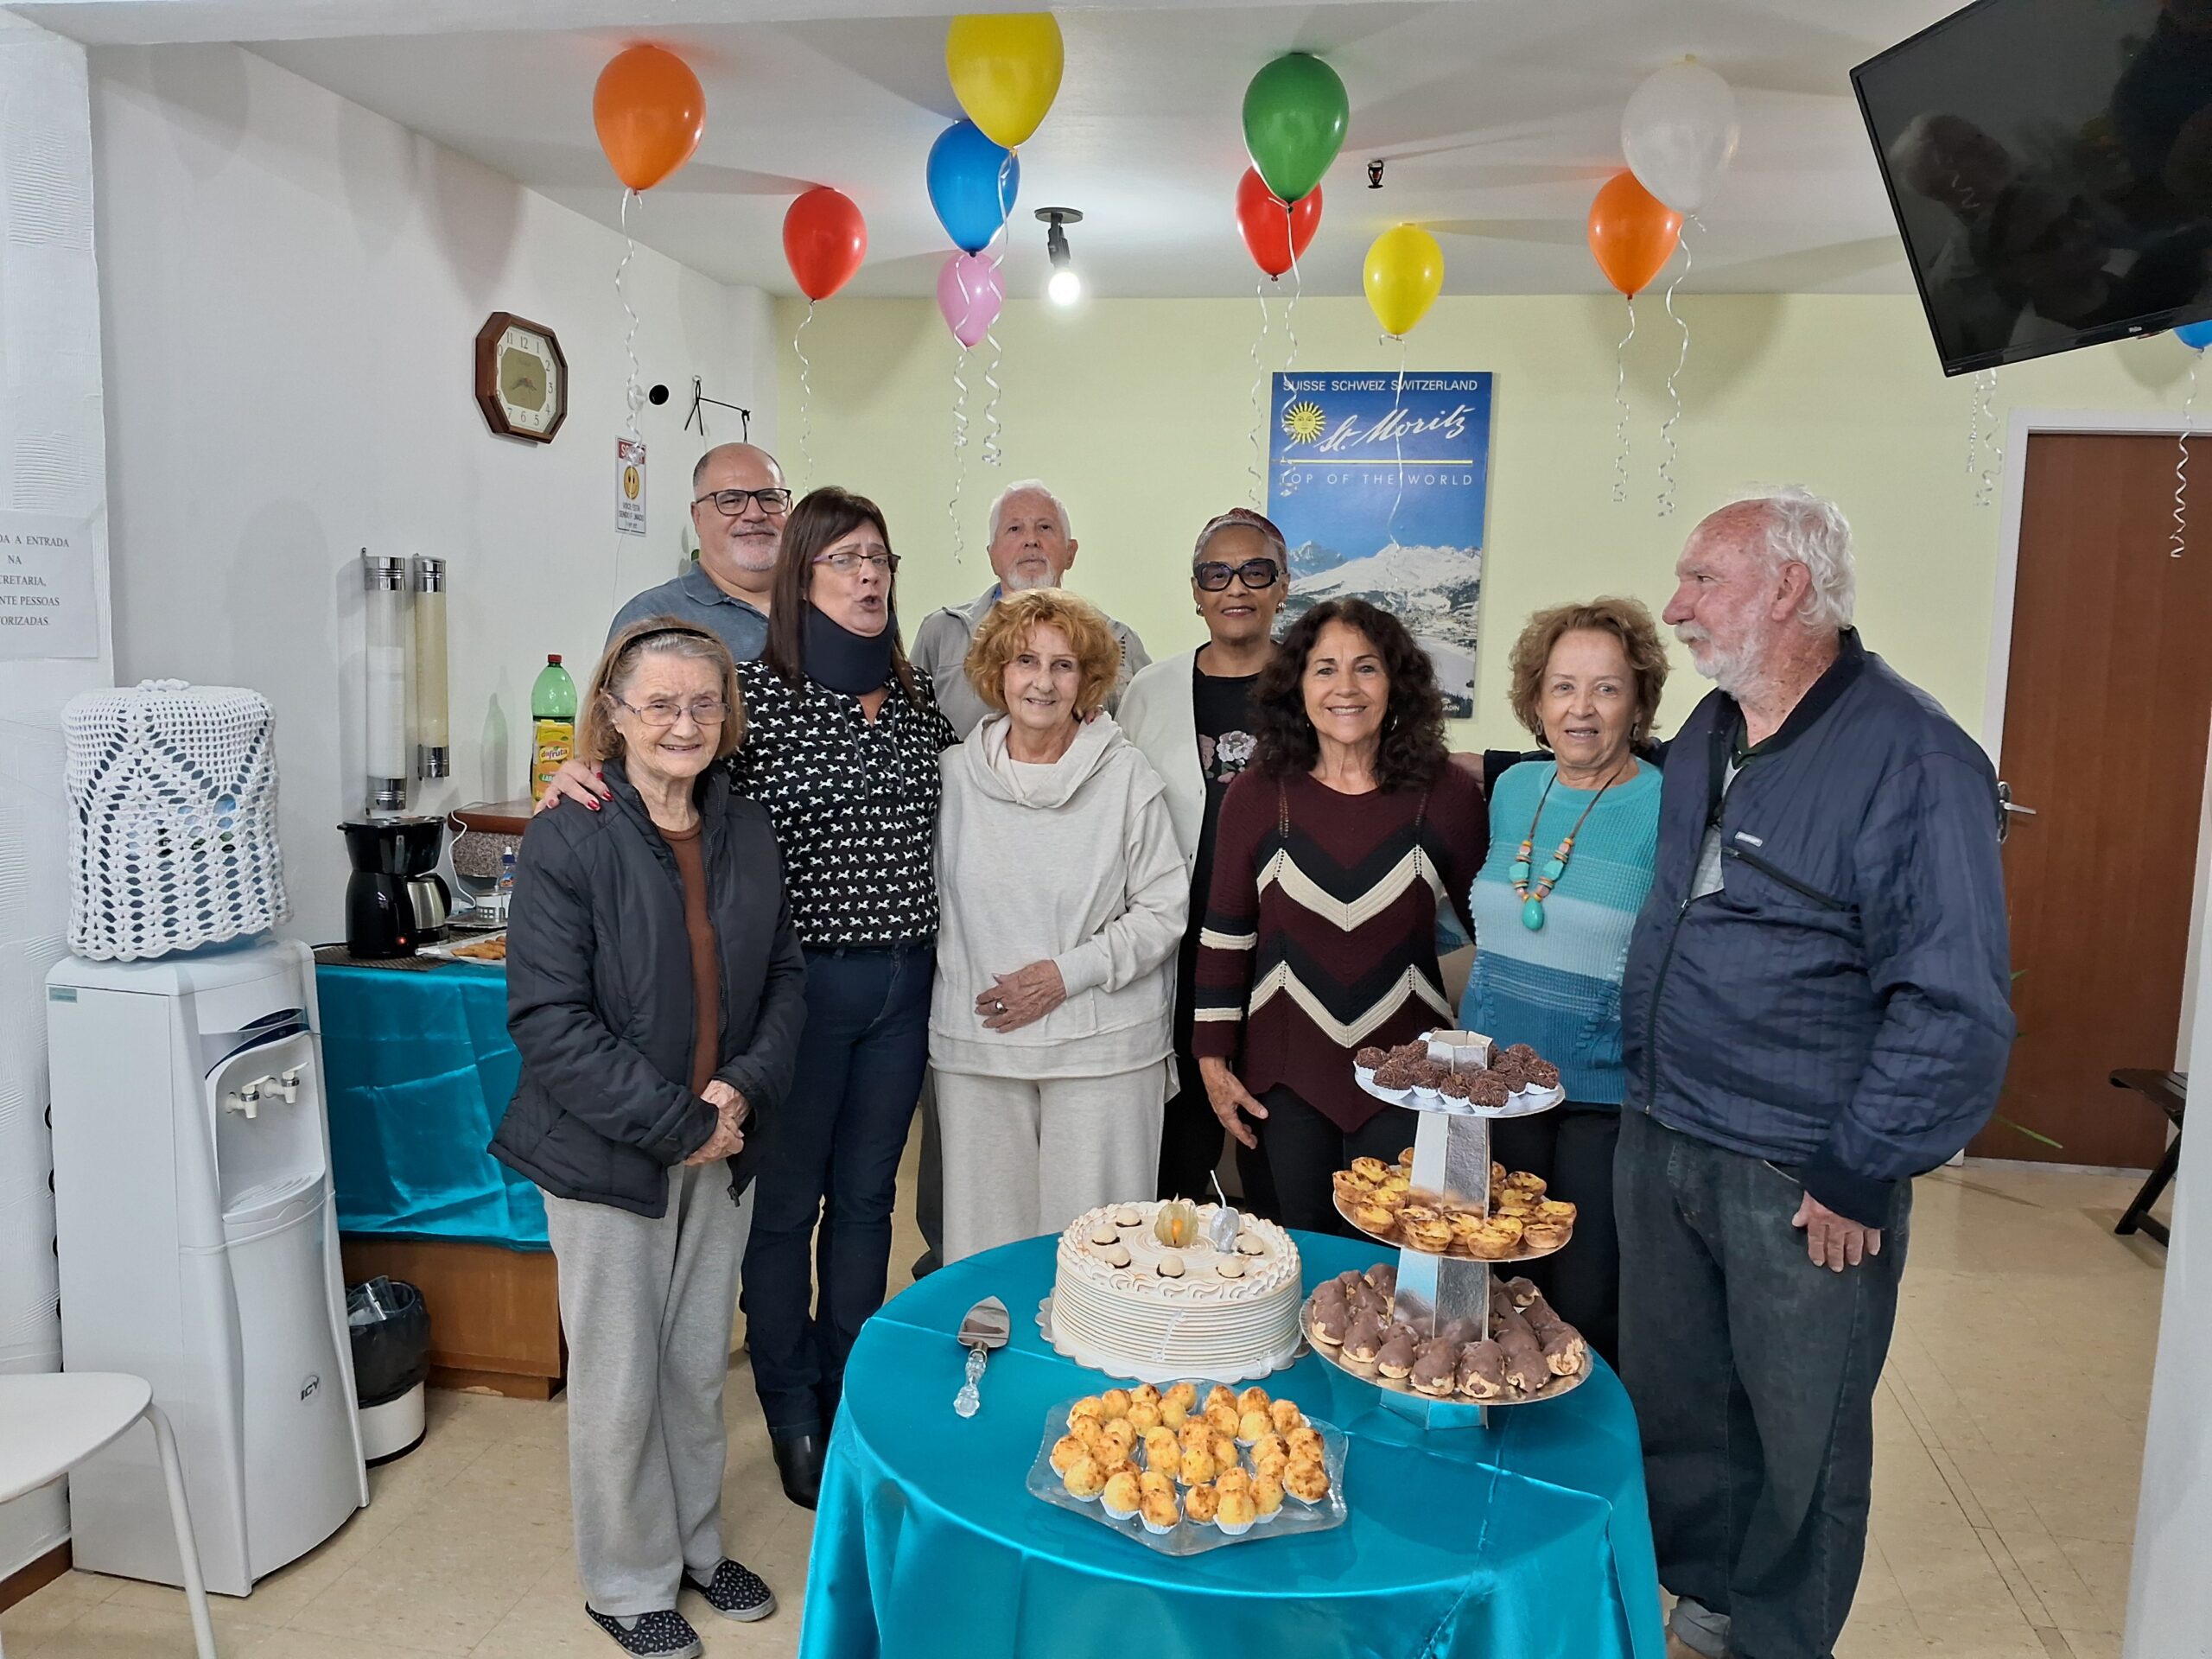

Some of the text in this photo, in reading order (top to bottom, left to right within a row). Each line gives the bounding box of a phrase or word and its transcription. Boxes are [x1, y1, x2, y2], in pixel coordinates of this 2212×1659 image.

[506, 332, 513, 345] 11
[520, 336, 528, 350] 12
[545, 359, 550, 372] 2
[548, 382, 553, 394] 3
[1283, 380, 1478, 391] SUISSE SCHWEIZ SWITZERLAND
[520, 410, 526, 423] 6
[534, 414, 539, 426] 5
[1313, 404, 1476, 453] St. Moritz
[1281, 474, 1472, 486] TOP OF THE WORLD
[15, 535, 22, 544] A
[26, 536, 70, 548] ENTRADA
[8, 555, 22, 565] NA
[20, 595, 60, 607] PESSOAS
[541, 749, 568, 759] dafruta
[301, 1376, 320, 1401] ICY
